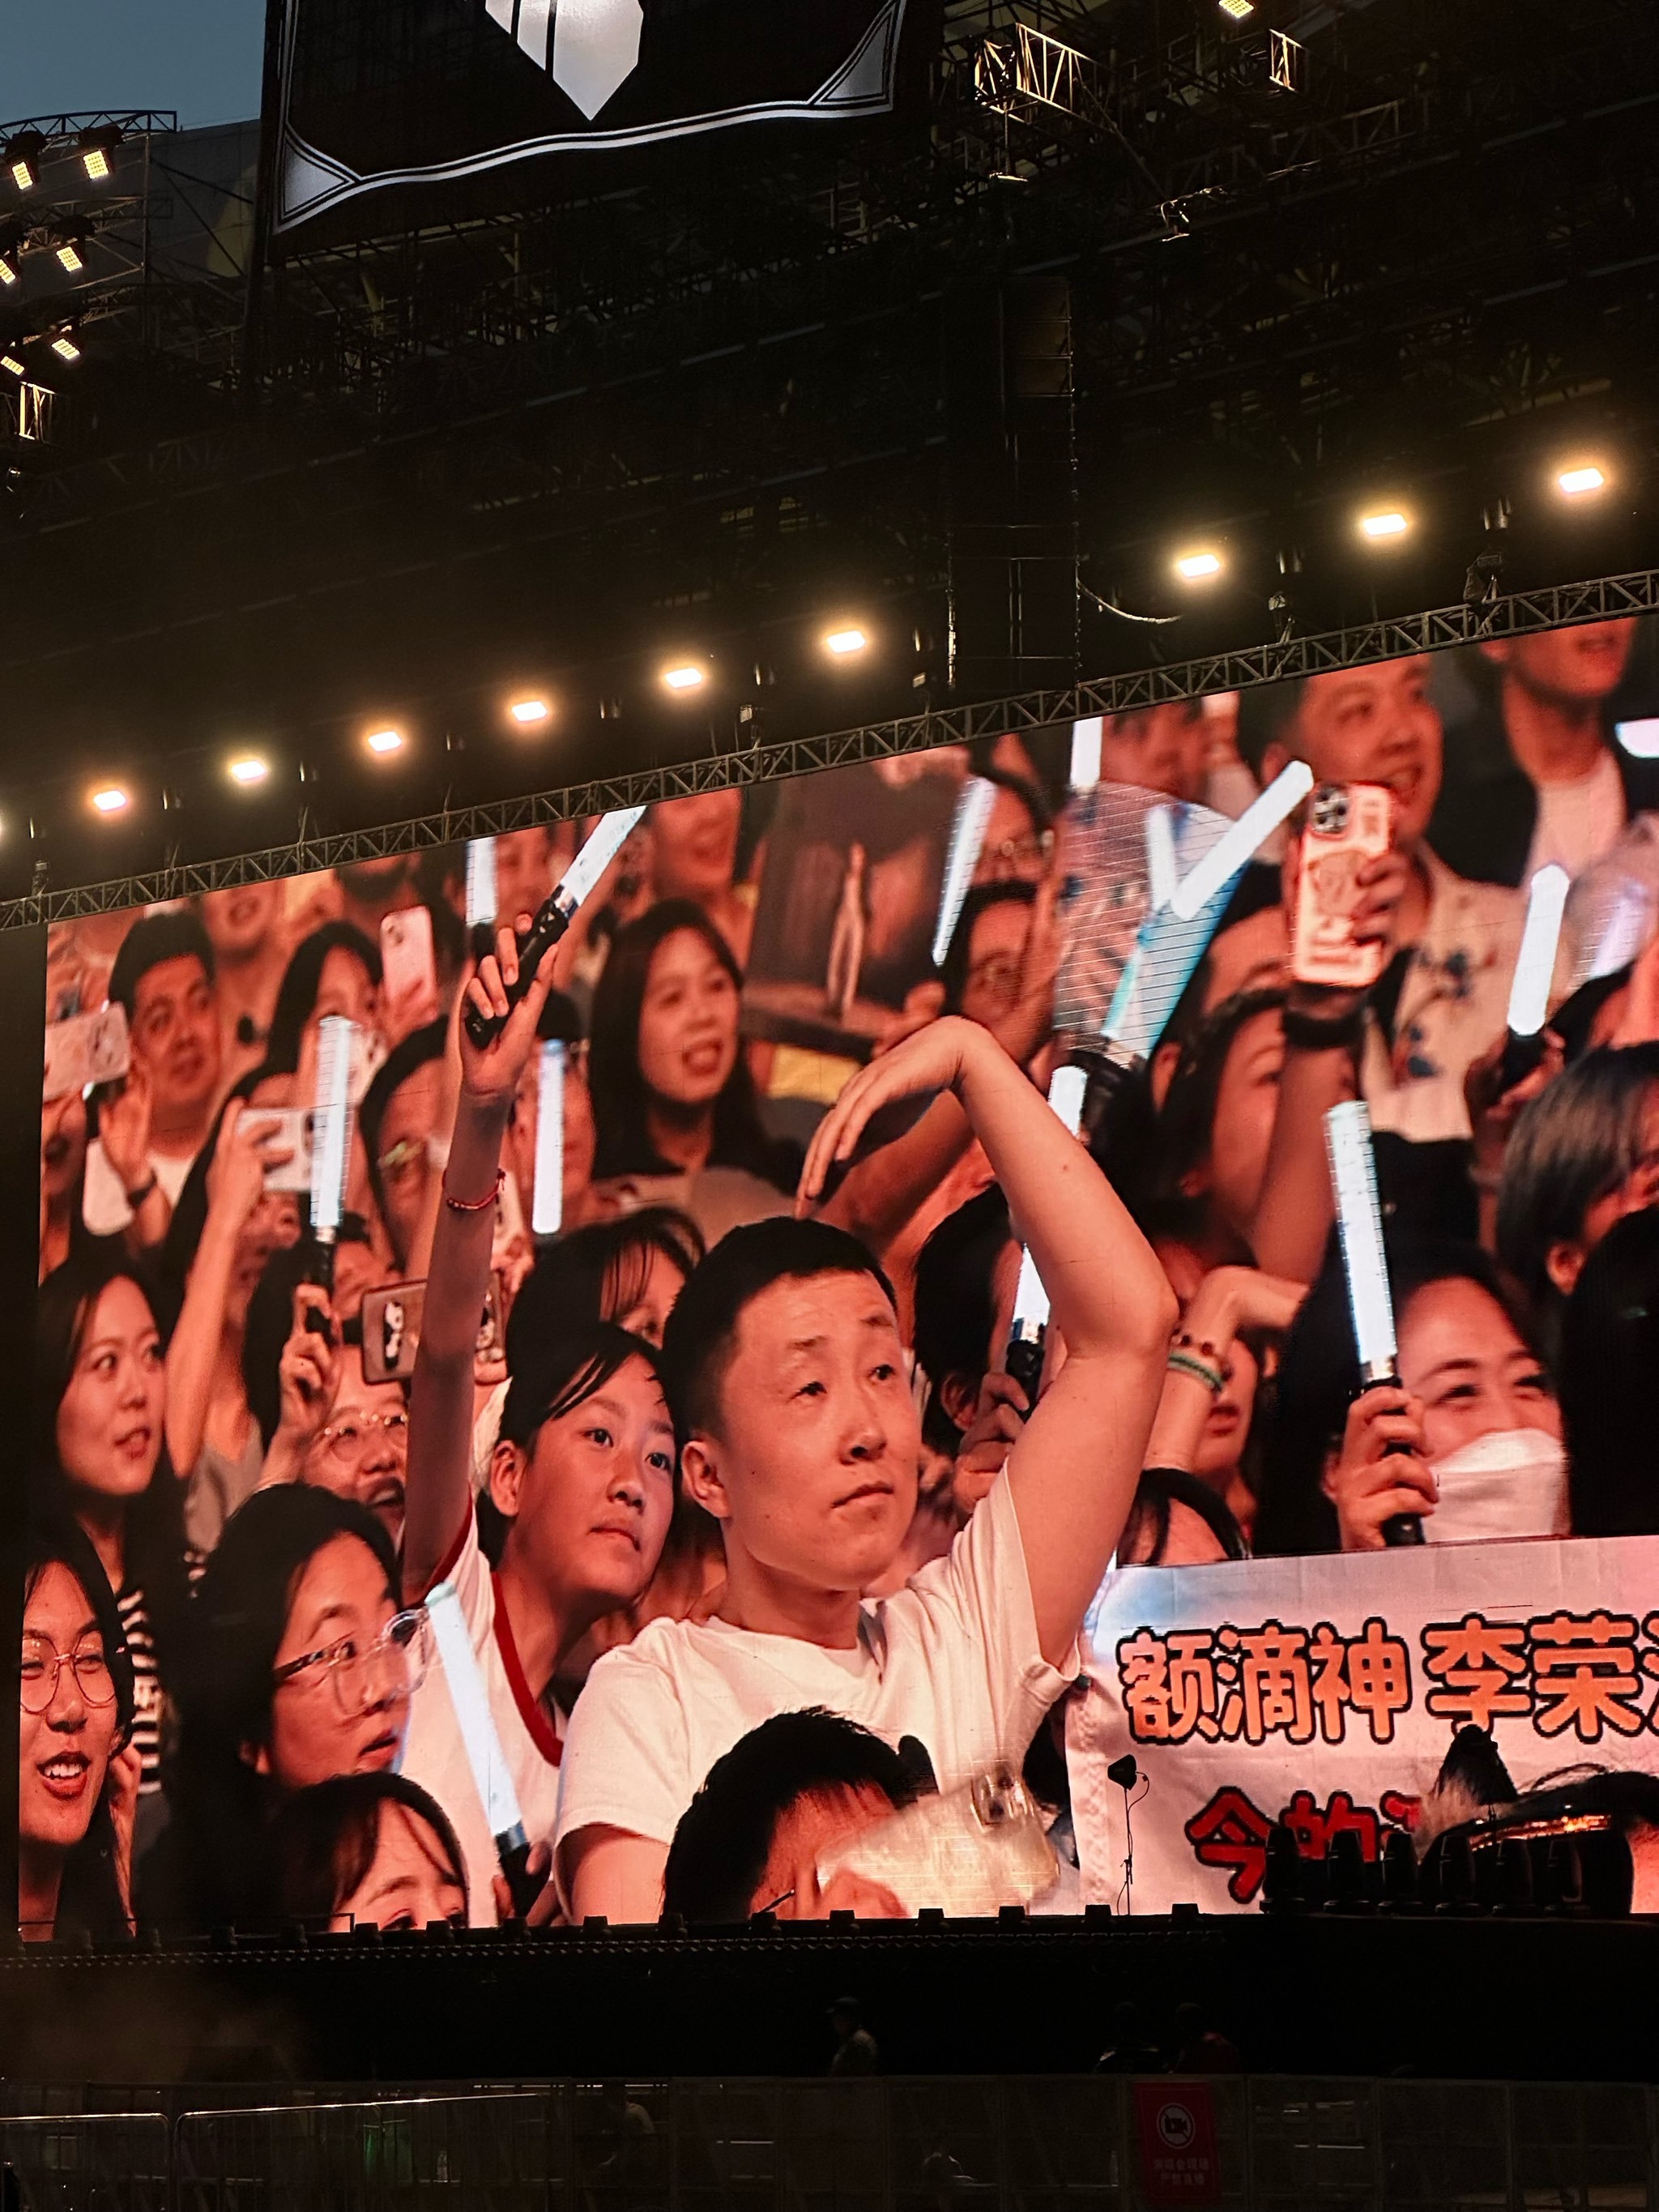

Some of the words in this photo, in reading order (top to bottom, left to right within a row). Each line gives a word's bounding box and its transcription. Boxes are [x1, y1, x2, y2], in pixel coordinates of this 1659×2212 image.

[1116, 1616, 1413, 1745] 额滴神
[1421, 1608, 1659, 1745] 李荣
